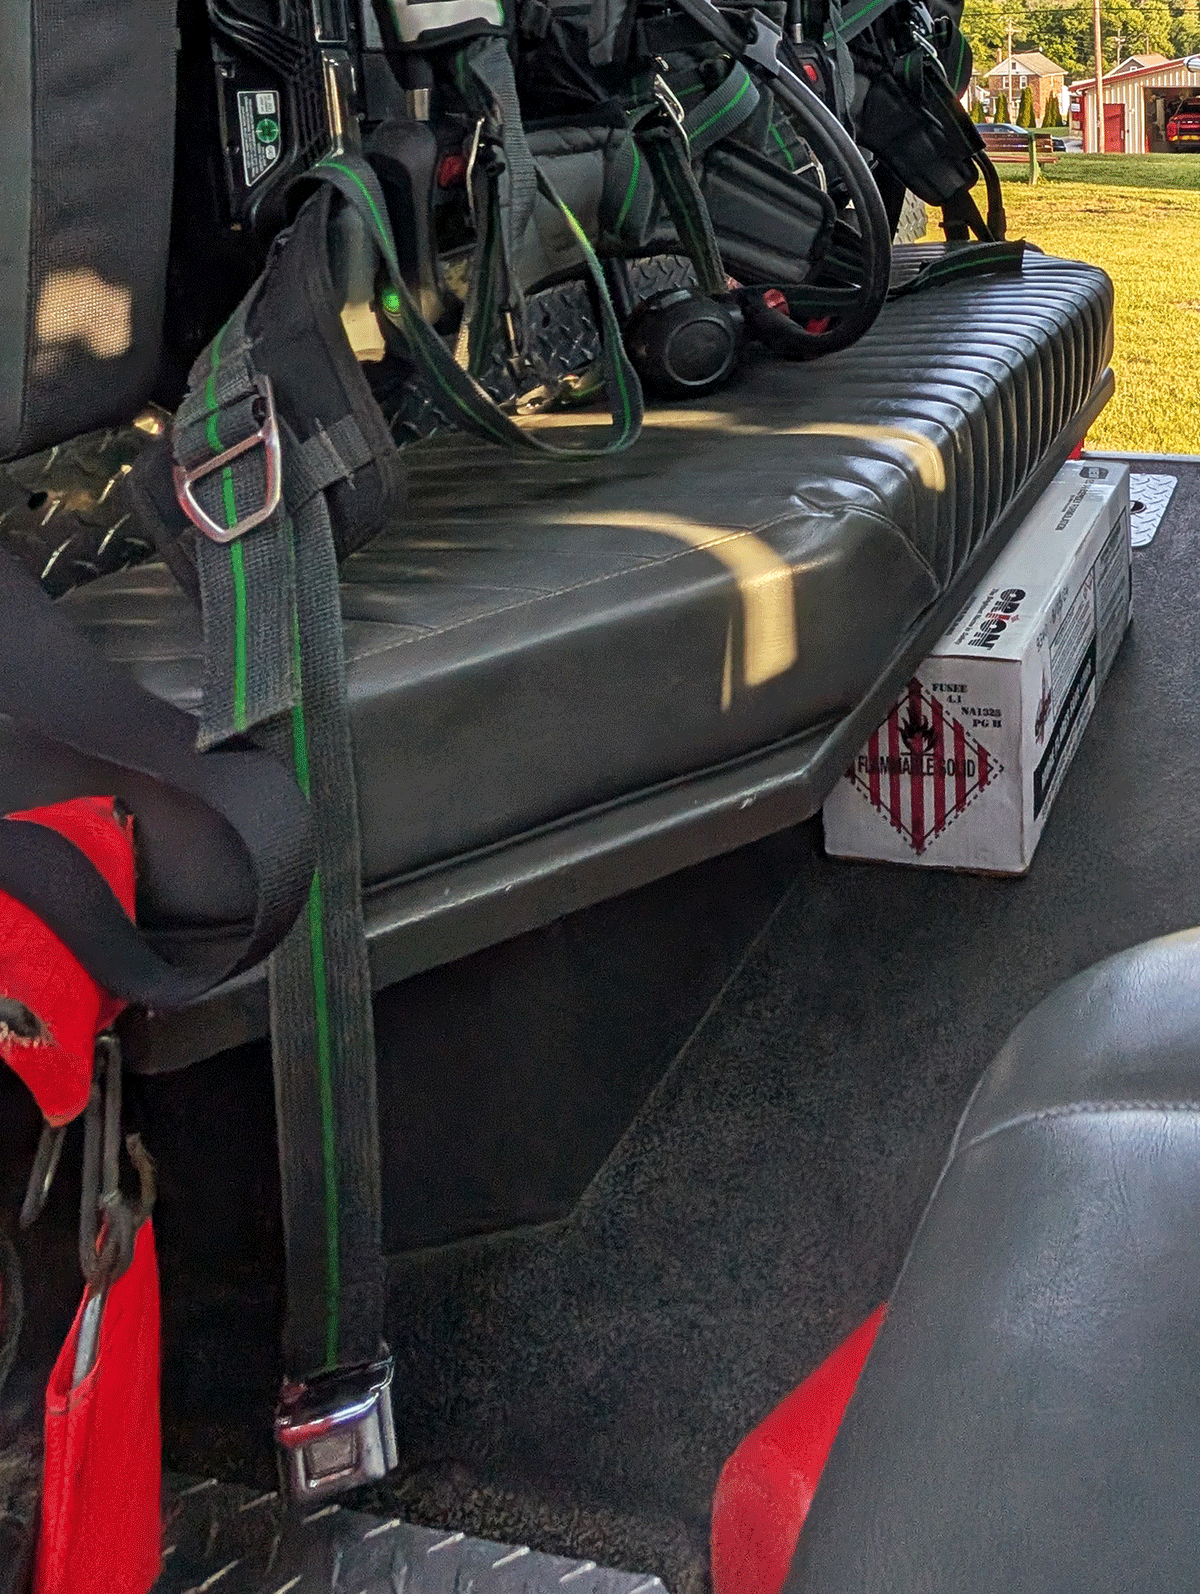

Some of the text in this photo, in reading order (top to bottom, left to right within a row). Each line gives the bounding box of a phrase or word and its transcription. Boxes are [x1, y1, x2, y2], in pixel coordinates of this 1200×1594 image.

[967, 588, 1026, 650] ORION
[931, 682, 967, 693] FUSEE
[972, 719, 989, 728] PG
